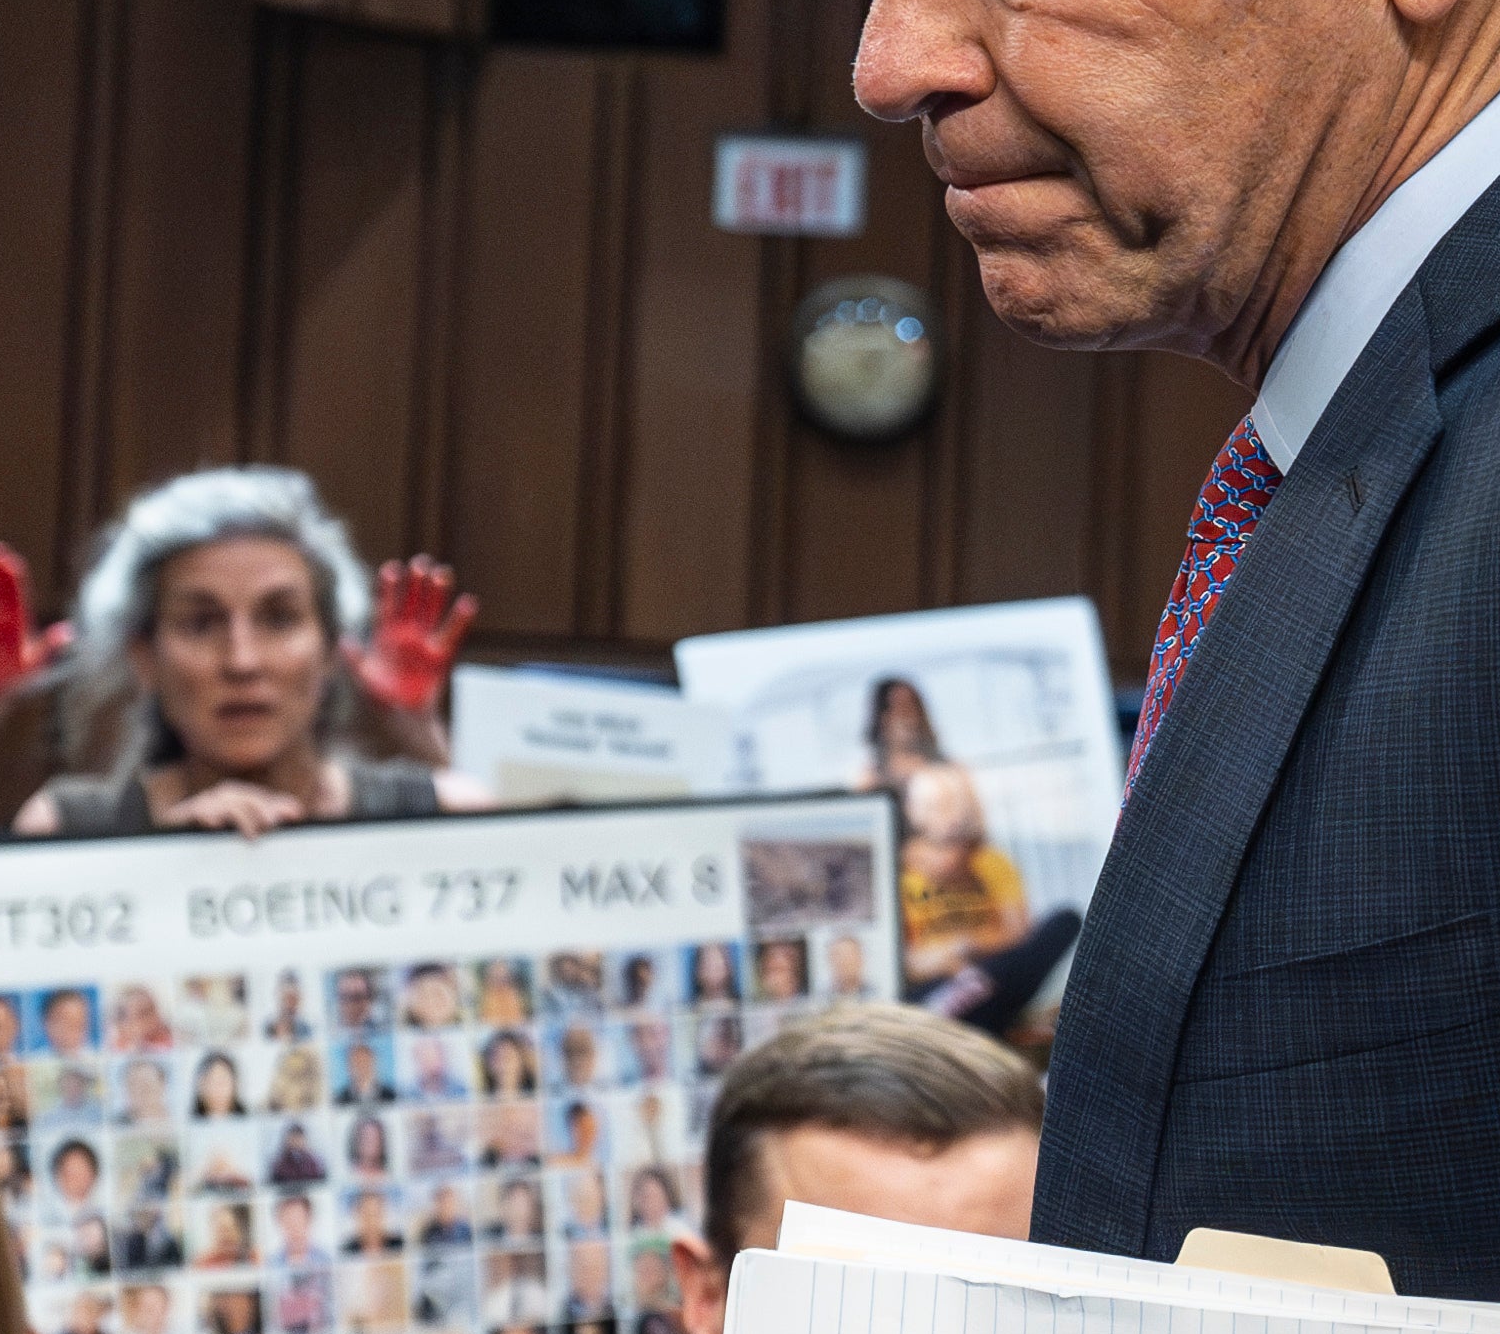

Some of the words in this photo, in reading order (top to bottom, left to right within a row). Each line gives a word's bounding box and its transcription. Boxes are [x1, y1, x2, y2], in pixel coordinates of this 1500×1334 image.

[185, 873, 404, 939] BOEING
[420, 866, 524, 921] 737
[557, 861, 677, 912] MAX
[688, 857, 729, 906] 8
